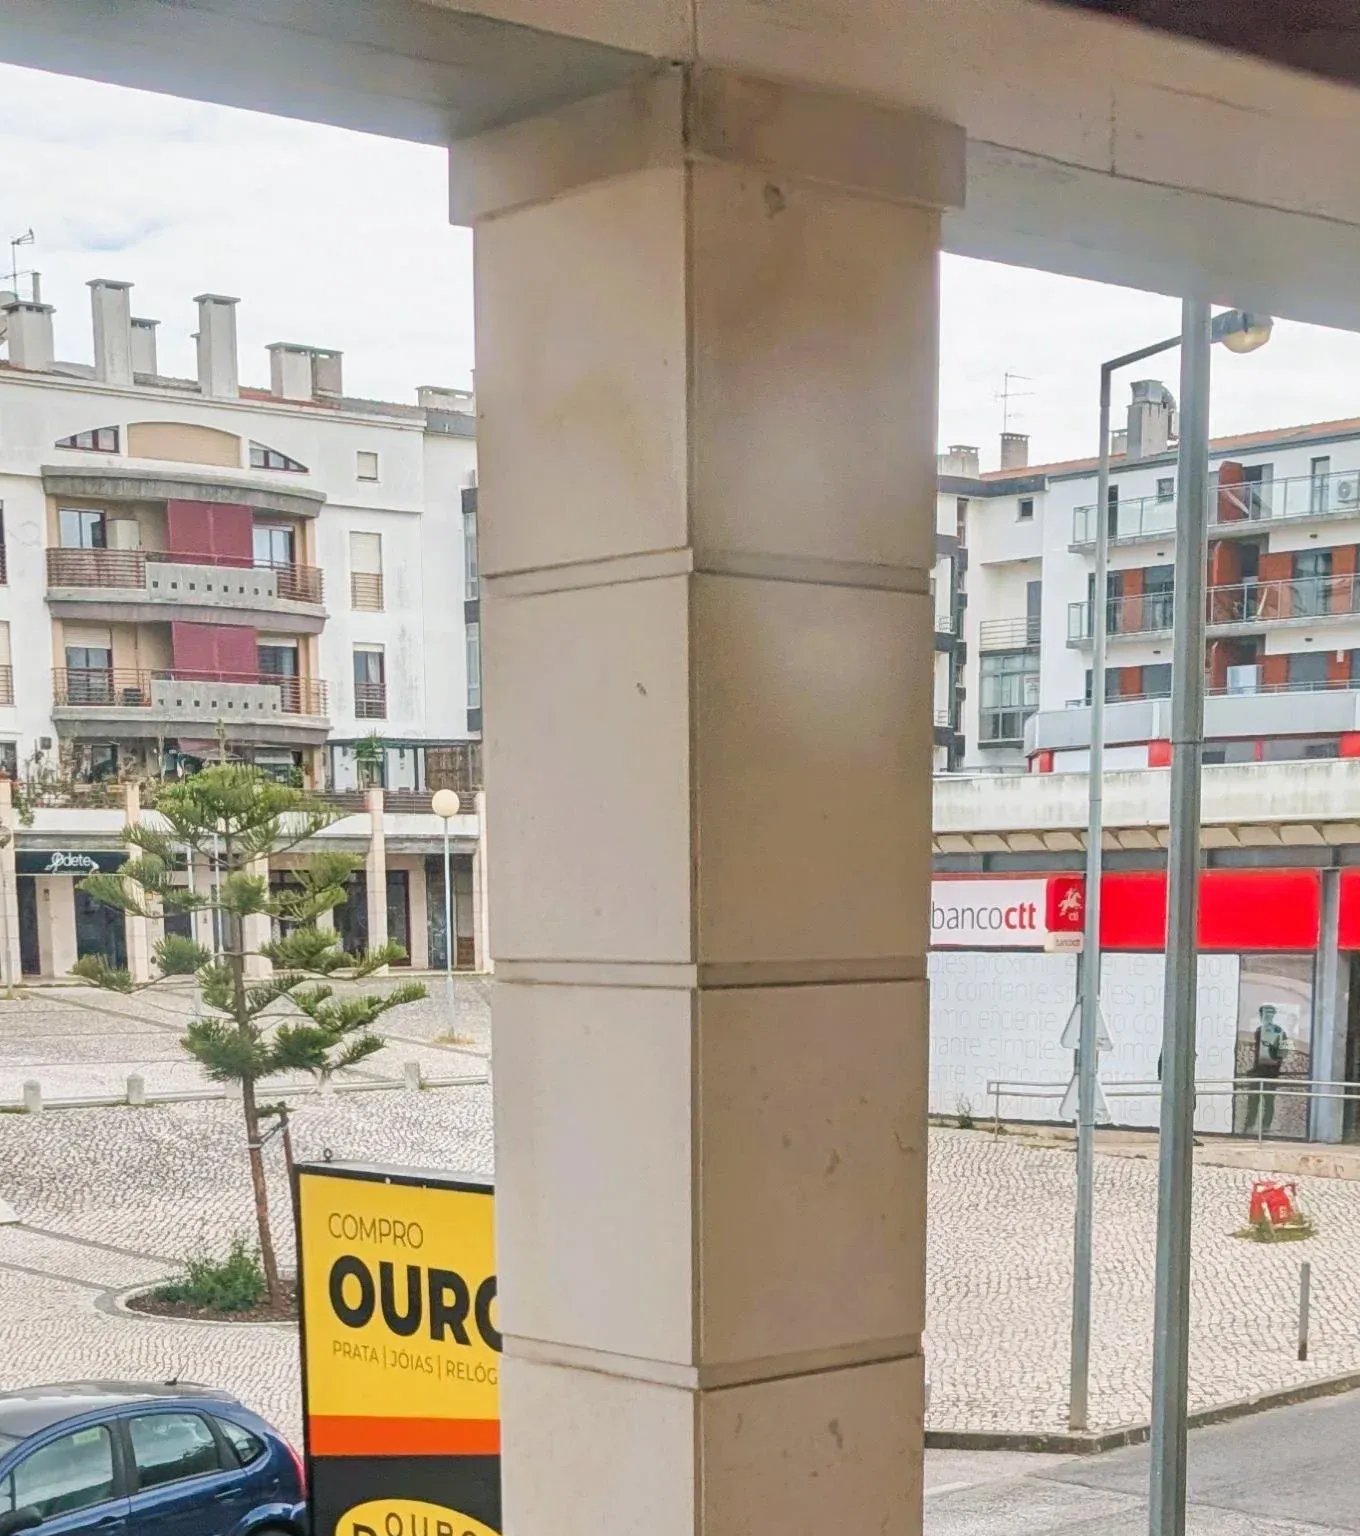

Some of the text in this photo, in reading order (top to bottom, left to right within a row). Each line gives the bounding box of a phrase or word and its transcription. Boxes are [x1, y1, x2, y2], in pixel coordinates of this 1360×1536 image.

[328, 1212, 424, 1249] COMPRO
[333, 1340, 379, 1364] PRATA
[391, 1349, 434, 1375] JÓIAS
